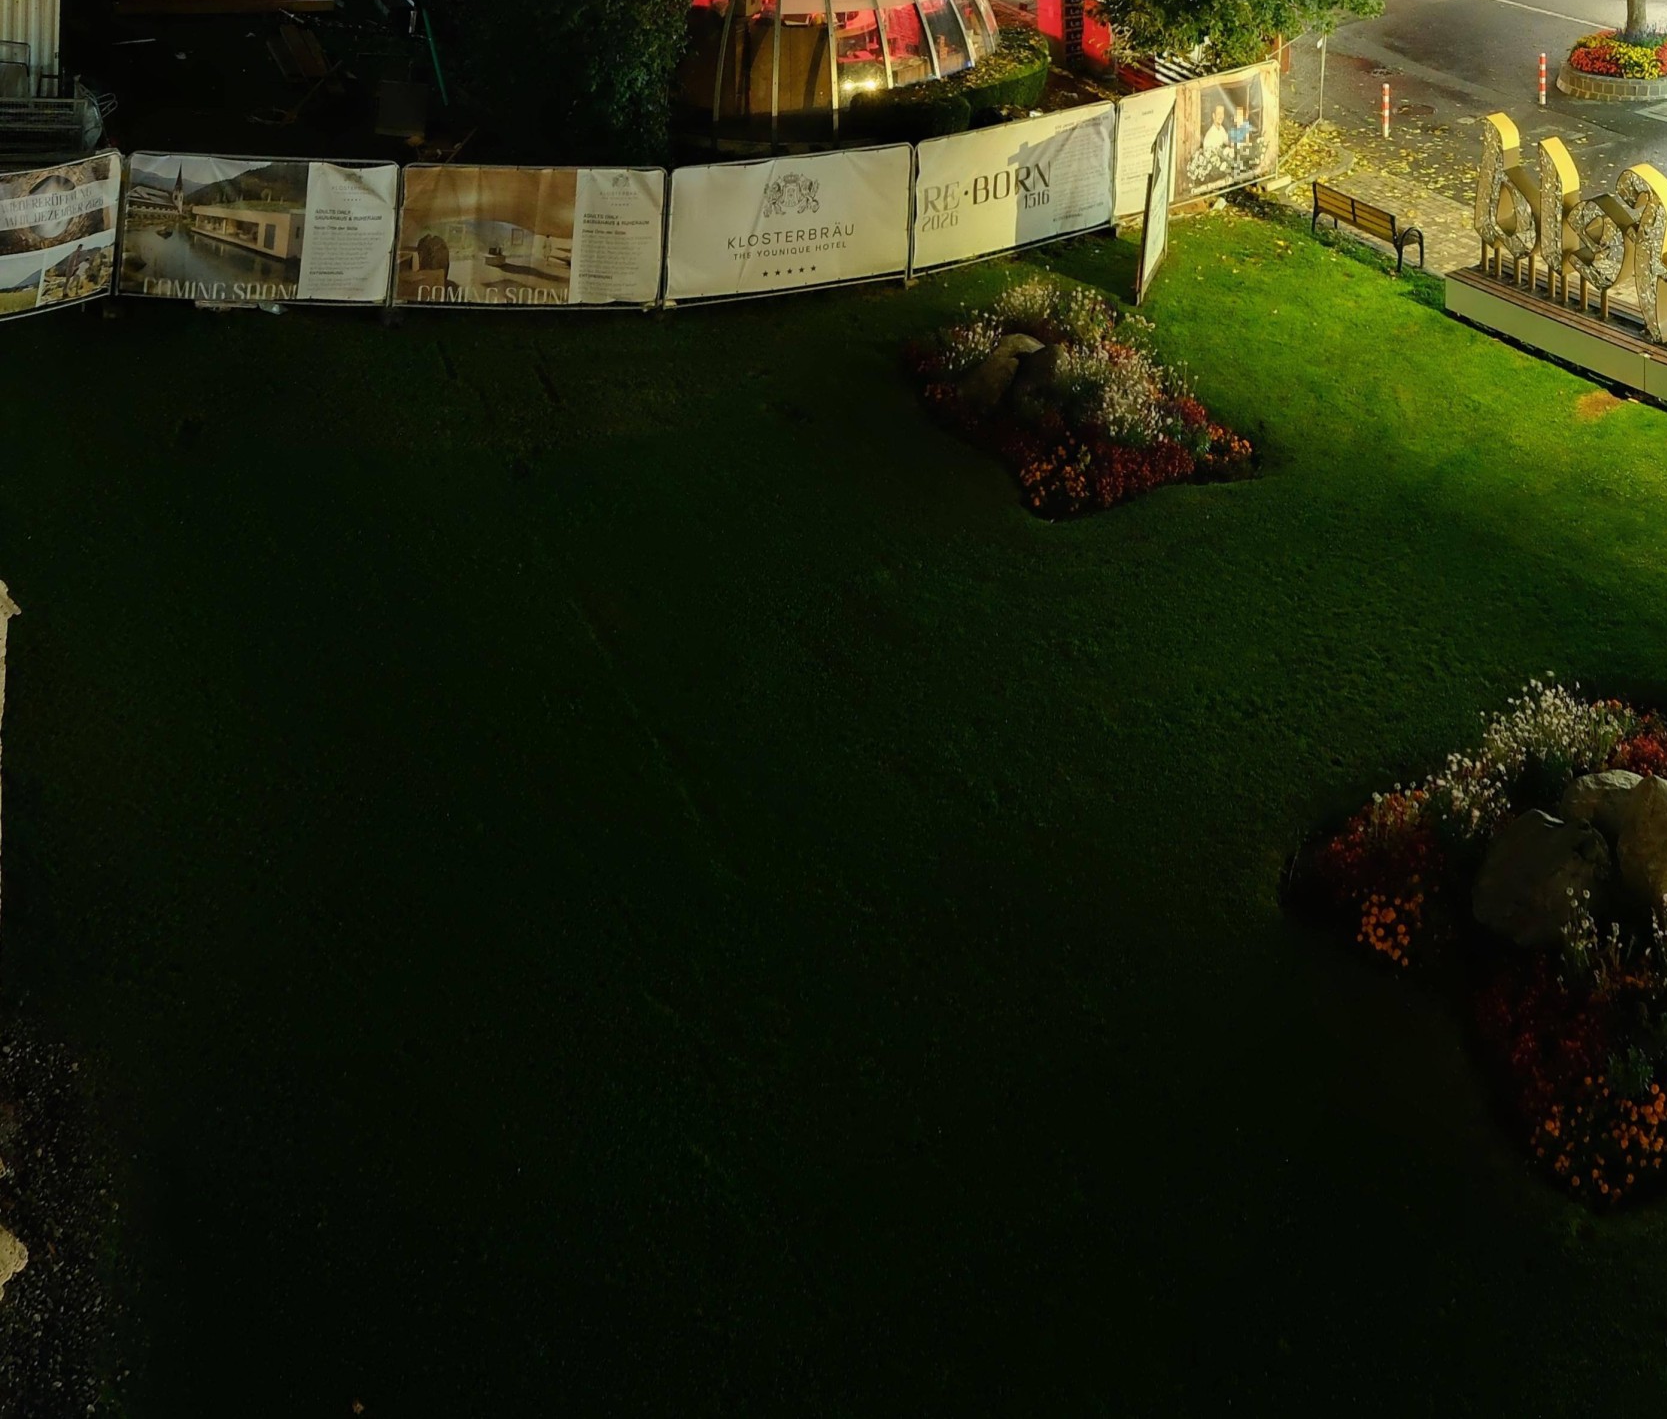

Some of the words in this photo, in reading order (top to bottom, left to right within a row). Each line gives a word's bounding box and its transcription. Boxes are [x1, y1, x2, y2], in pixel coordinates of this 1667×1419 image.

[1022, 190, 1051, 210] 1516
[727, 222, 855, 250] KLOSTERBRÄU
[733, 252, 752, 260] THE
[756, 245, 811, 258] YOUNIQUE
[814, 241, 847, 252] HOTEL
